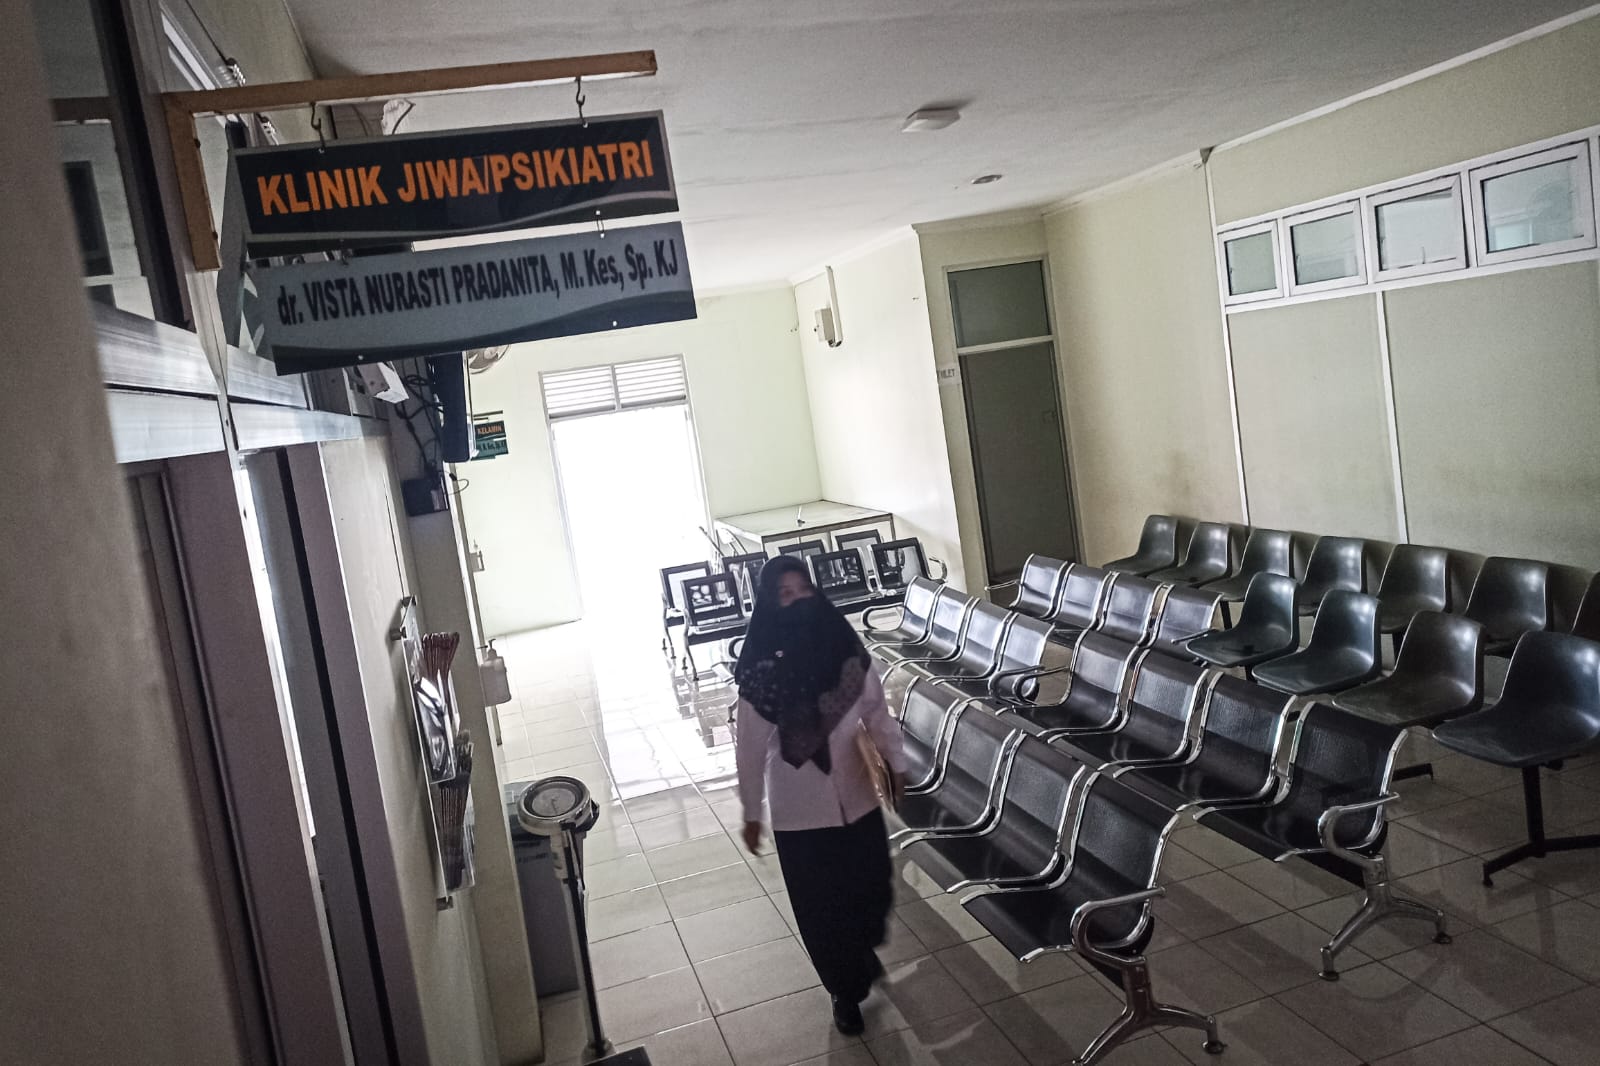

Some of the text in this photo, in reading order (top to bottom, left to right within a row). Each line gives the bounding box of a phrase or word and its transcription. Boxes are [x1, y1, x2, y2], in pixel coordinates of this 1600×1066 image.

[258, 140, 653, 215] KLINIK JIWA/PSIKIATRI
[277, 285, 304, 325] dr.
[303, 277, 365, 322] VISTA
[364, 266, 450, 315] NURASTI
[451, 254, 560, 303] PRADANITA,
[654, 239, 678, 277] KJ
